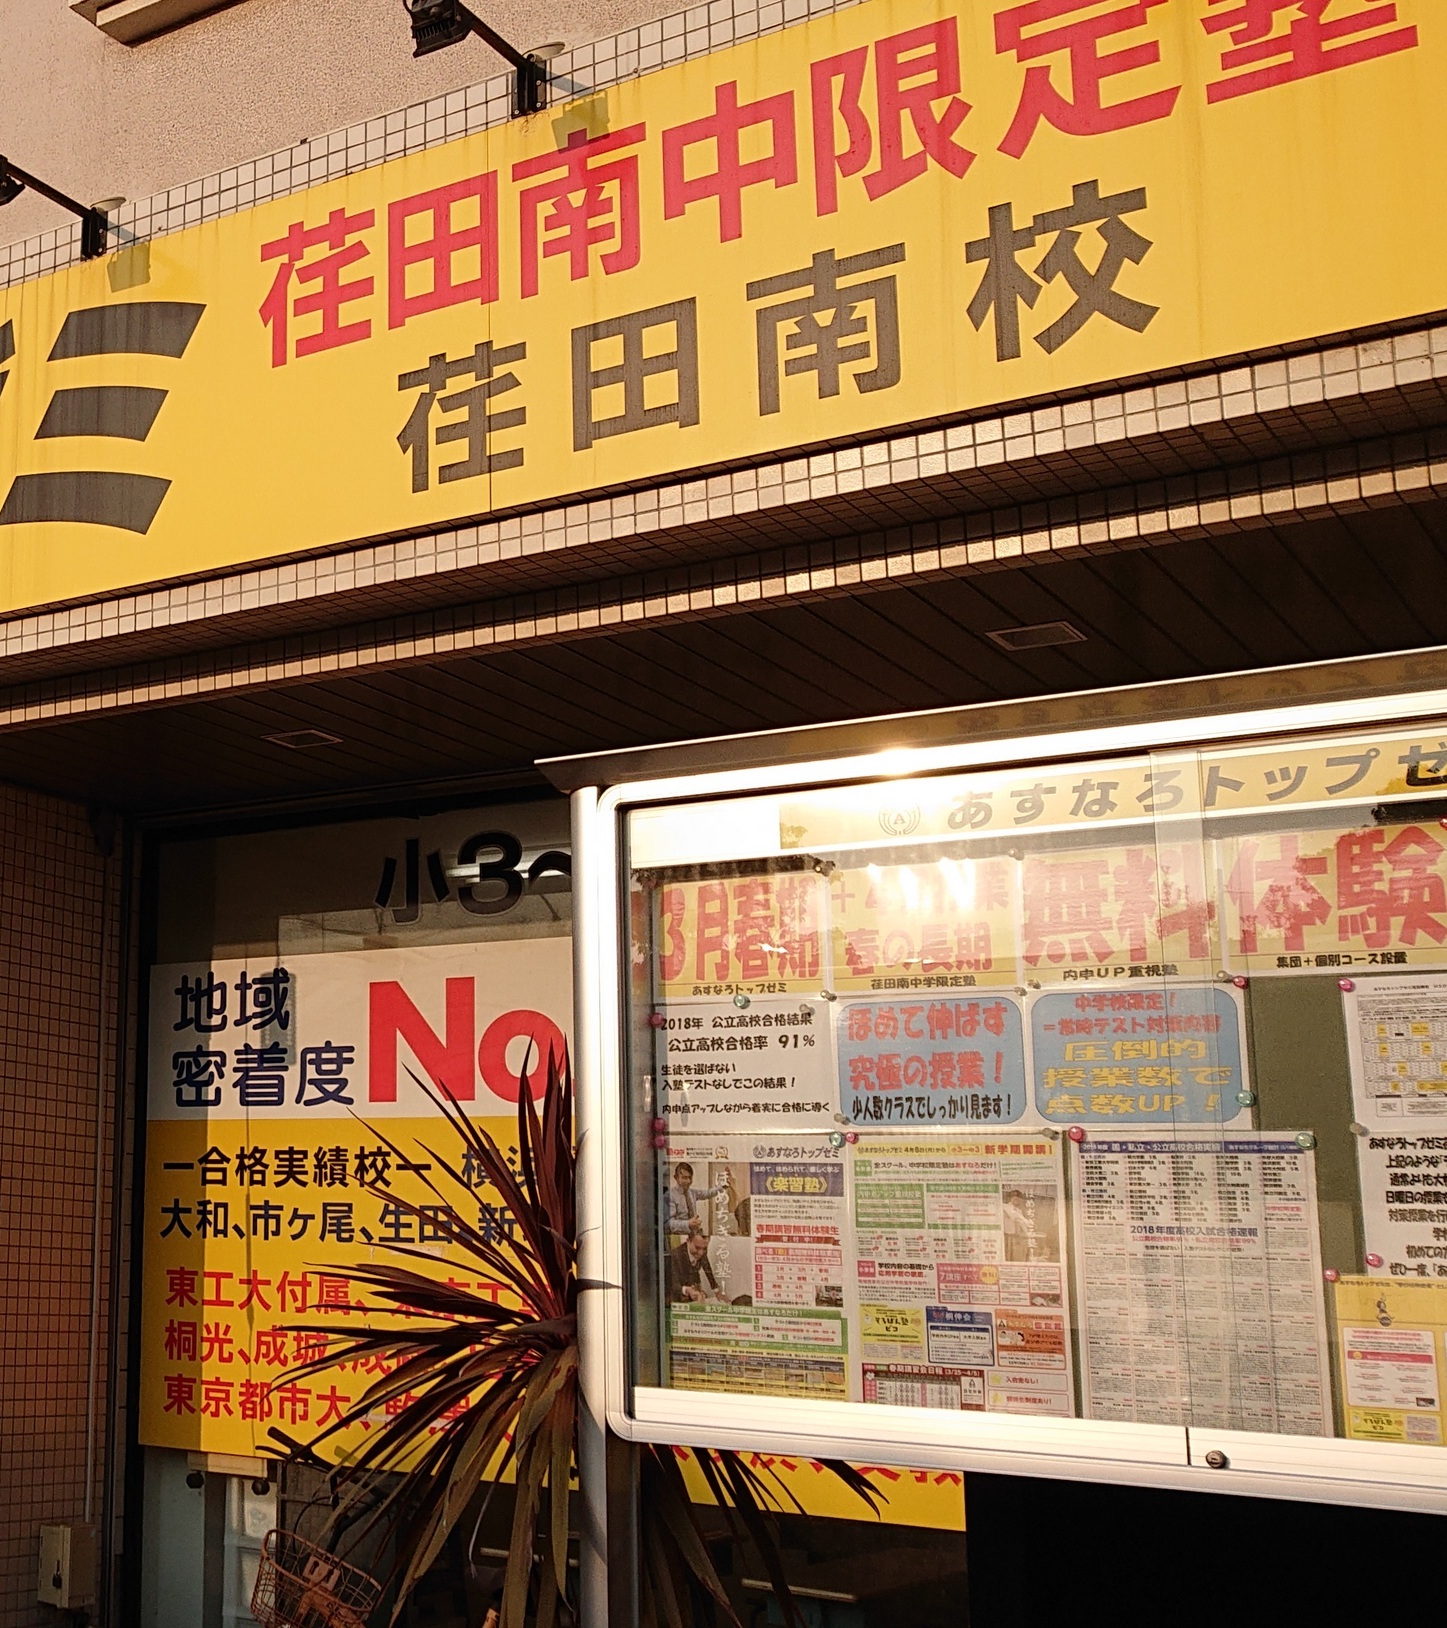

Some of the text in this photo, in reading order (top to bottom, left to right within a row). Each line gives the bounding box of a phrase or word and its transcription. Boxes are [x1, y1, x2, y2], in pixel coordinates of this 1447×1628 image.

[396, 179, 1160, 494] 荏田南校
[946, 742, 1447, 832] あすなろトップゼ
[844, 824, 1447, 977] 春の長期 無料体験
[691, 982, 788, 996] あすなろトップゼミ
[870, 974, 978, 991] 荏田南中学限定塾
[172, 966, 292, 1034] 地域
[711, 1011, 813, 1030] 公立高校合格結果
[847, 1001, 1009, 1042] ほめて伸ばす
[667, 1034, 816, 1053] 公立高校合格率 91%
[1063, 1038, 1208, 1063] 圧倒的
[171, 1040, 356, 1110] 密着度
[661, 1062, 737, 1077] 生徒を選ばない
[848, 1050, 1005, 1092] 究極の授業！
[1042, 1066, 1234, 1090] 授業数で
[661, 1101, 831, 1115] 内申点アップしながら着実に合格に導く
[851, 1093, 1012, 1121] 少人数クラスでしっかり見ます！
[766, 1146, 840, 1160] あすなろトップゼミ
